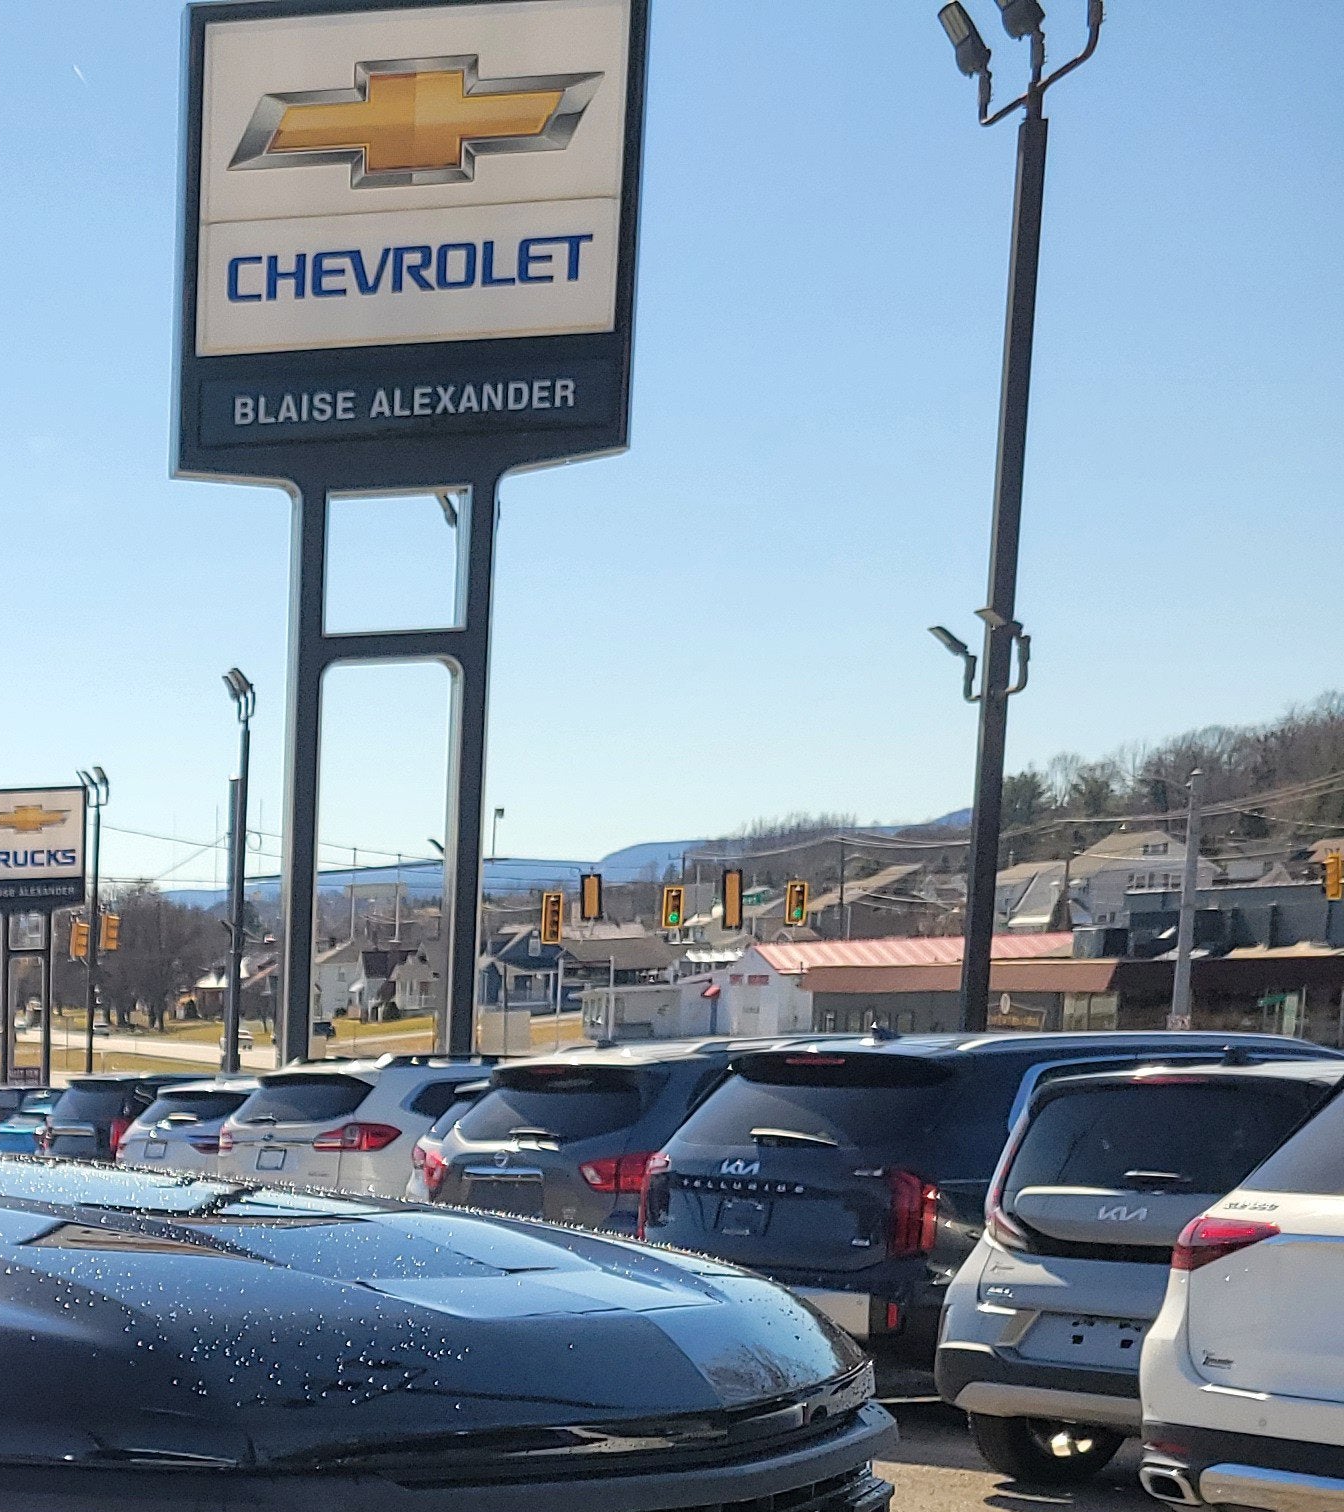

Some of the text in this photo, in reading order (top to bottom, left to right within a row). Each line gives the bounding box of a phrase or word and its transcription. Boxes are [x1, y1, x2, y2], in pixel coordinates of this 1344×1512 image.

[226, 232, 594, 303] CHEVROLET
[233, 377, 577, 427] BLAISE ALEXANDER
[18, 885, 75, 897] ALEXANDER
